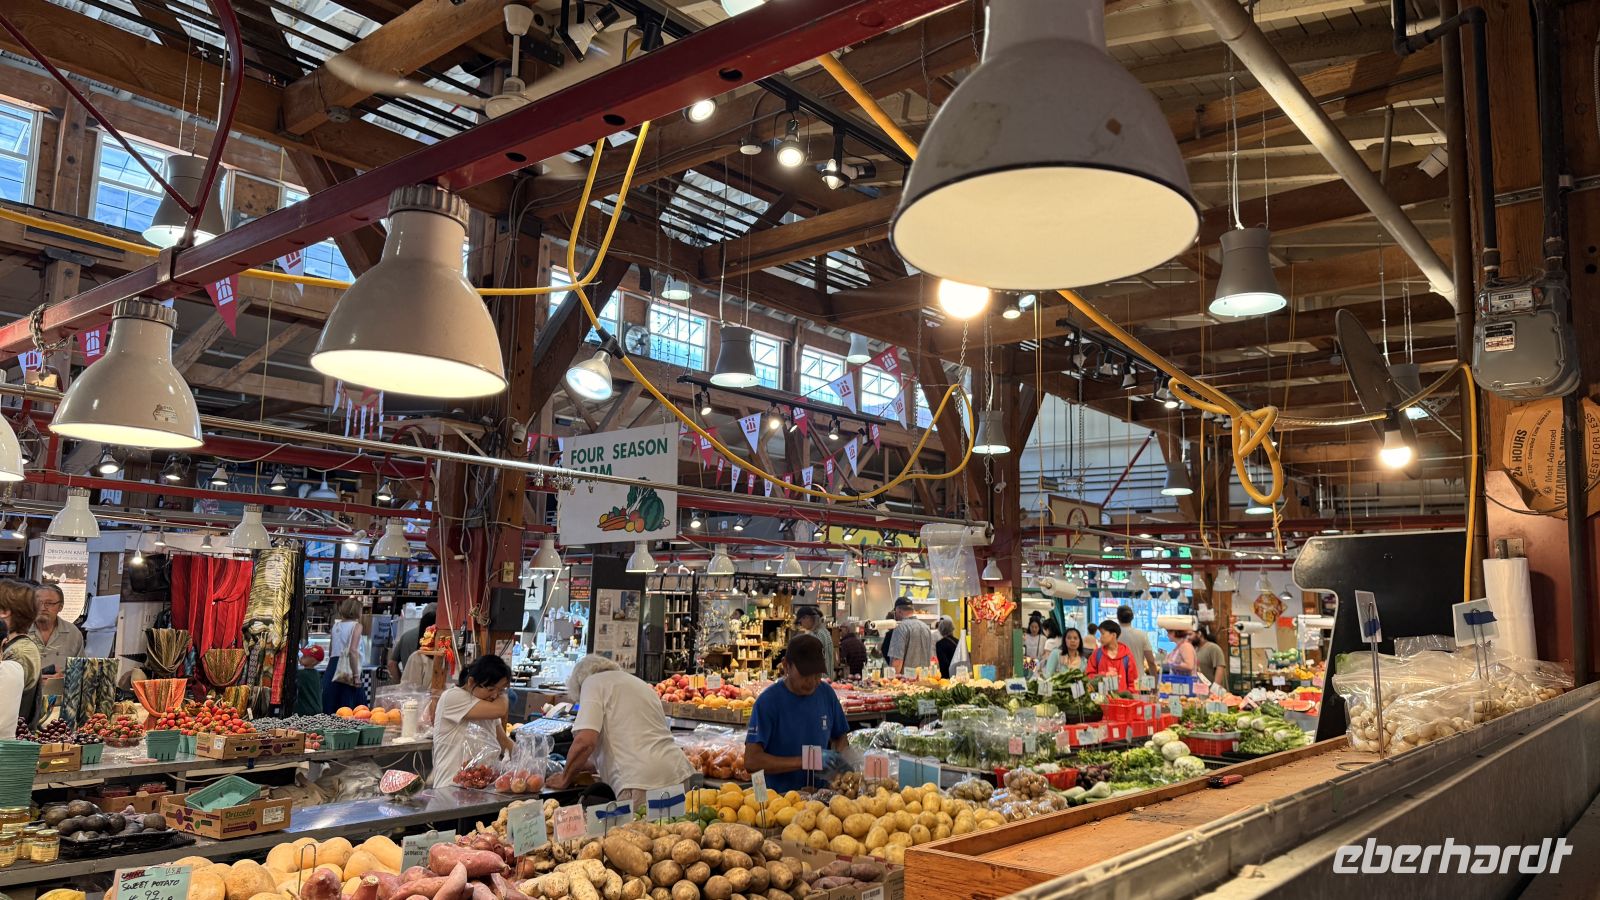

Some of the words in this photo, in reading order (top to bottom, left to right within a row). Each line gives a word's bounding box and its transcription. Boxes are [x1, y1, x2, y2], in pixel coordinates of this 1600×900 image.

[1584, 412, 1599, 435] LESS
[571, 446, 605, 465] FOUR
[612, 437, 668, 460] SEASON
[1512, 430, 1528, 462] HOURS
[1546, 429, 1557, 463] Advanced
[1592, 436, 1600, 455] FOR
[570, 464, 613, 484] ARM
[1512, 466, 1523, 478] 24
[1545, 466, 1554, 483] Most
[1587, 457, 1600, 480] BEST
[121, 880, 149, 891] SWEET
[151, 879, 180, 888] POTATO
